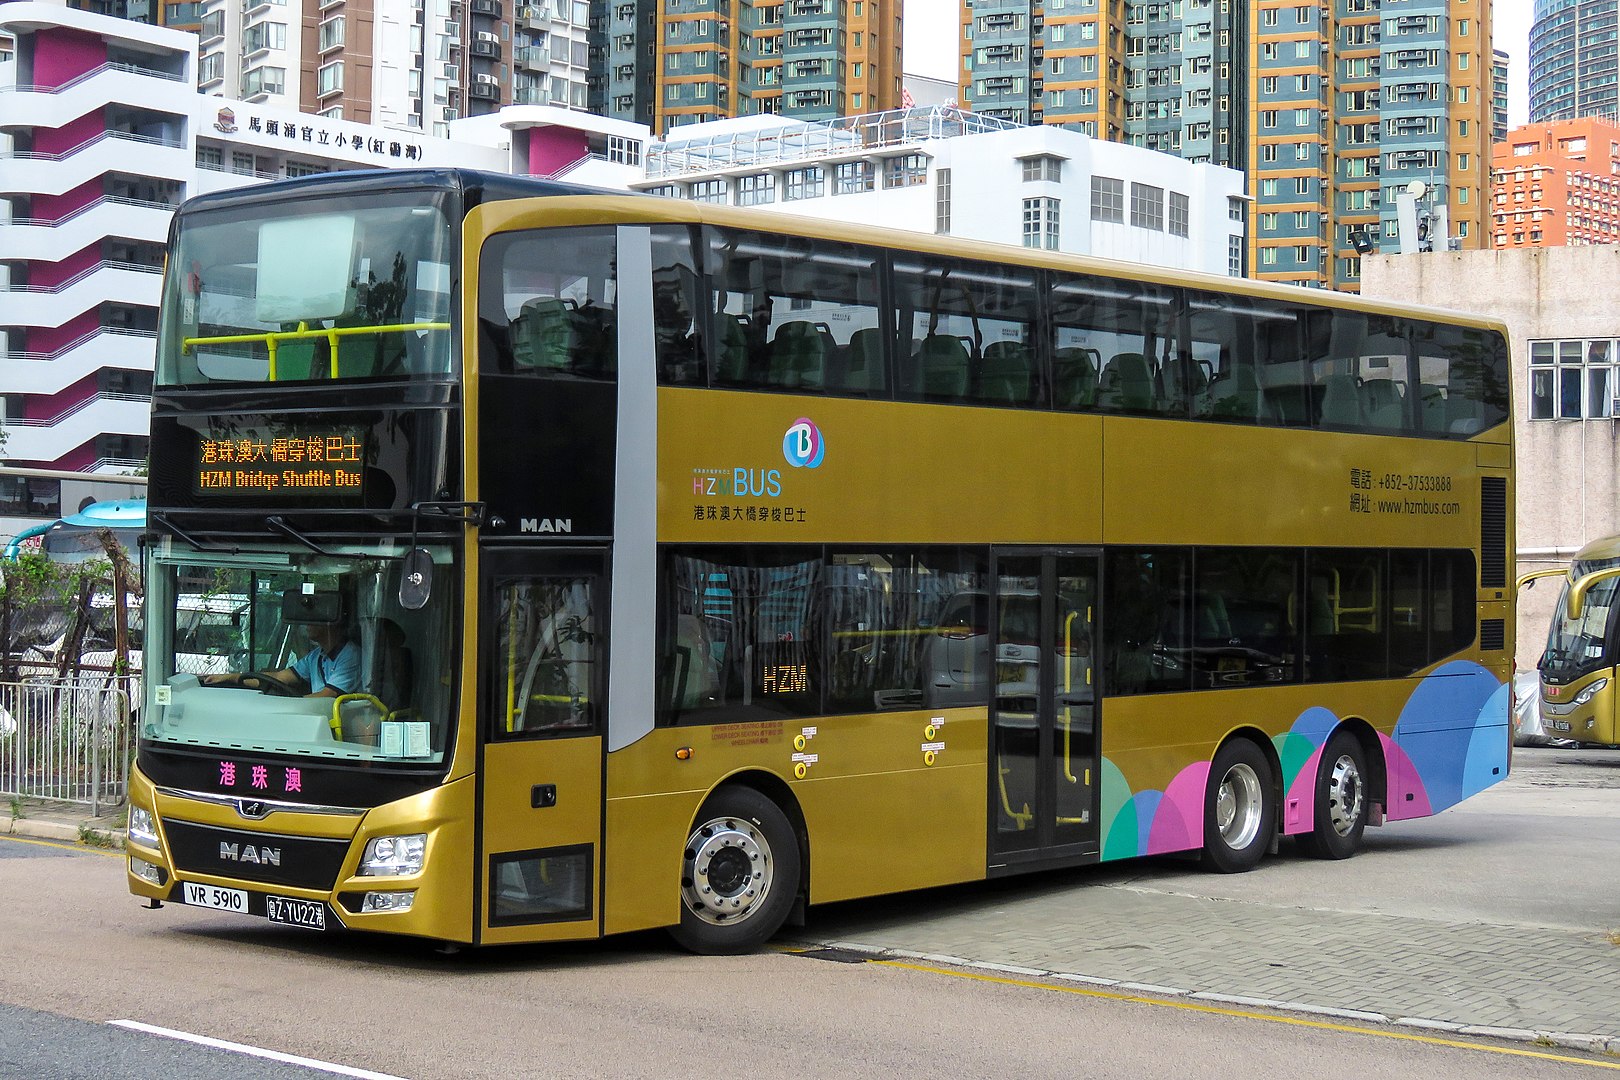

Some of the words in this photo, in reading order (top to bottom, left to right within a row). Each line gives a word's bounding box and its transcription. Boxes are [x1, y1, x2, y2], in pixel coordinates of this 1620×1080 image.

[200, 435, 361, 463] 港珠澳大橋穿梭巴士
[200, 470, 232, 487] HZM
[235, 470, 279, 491] Bridge
[282, 470, 331, 487] Shuttle
[335, 469, 361, 487] Bus
[693, 505, 807, 522] 港珠澳大橋穿梭巴士
[1378, 498, 1460, 515] www.hzmbus.com
[520, 518, 572, 533] MAN
[763, 664, 806, 693] HZM
[220, 761, 302, 793] 港珠澳
[220, 841, 281, 866] MAN
[189, 886, 207, 904] VR
[213, 890, 242, 910] 5910
